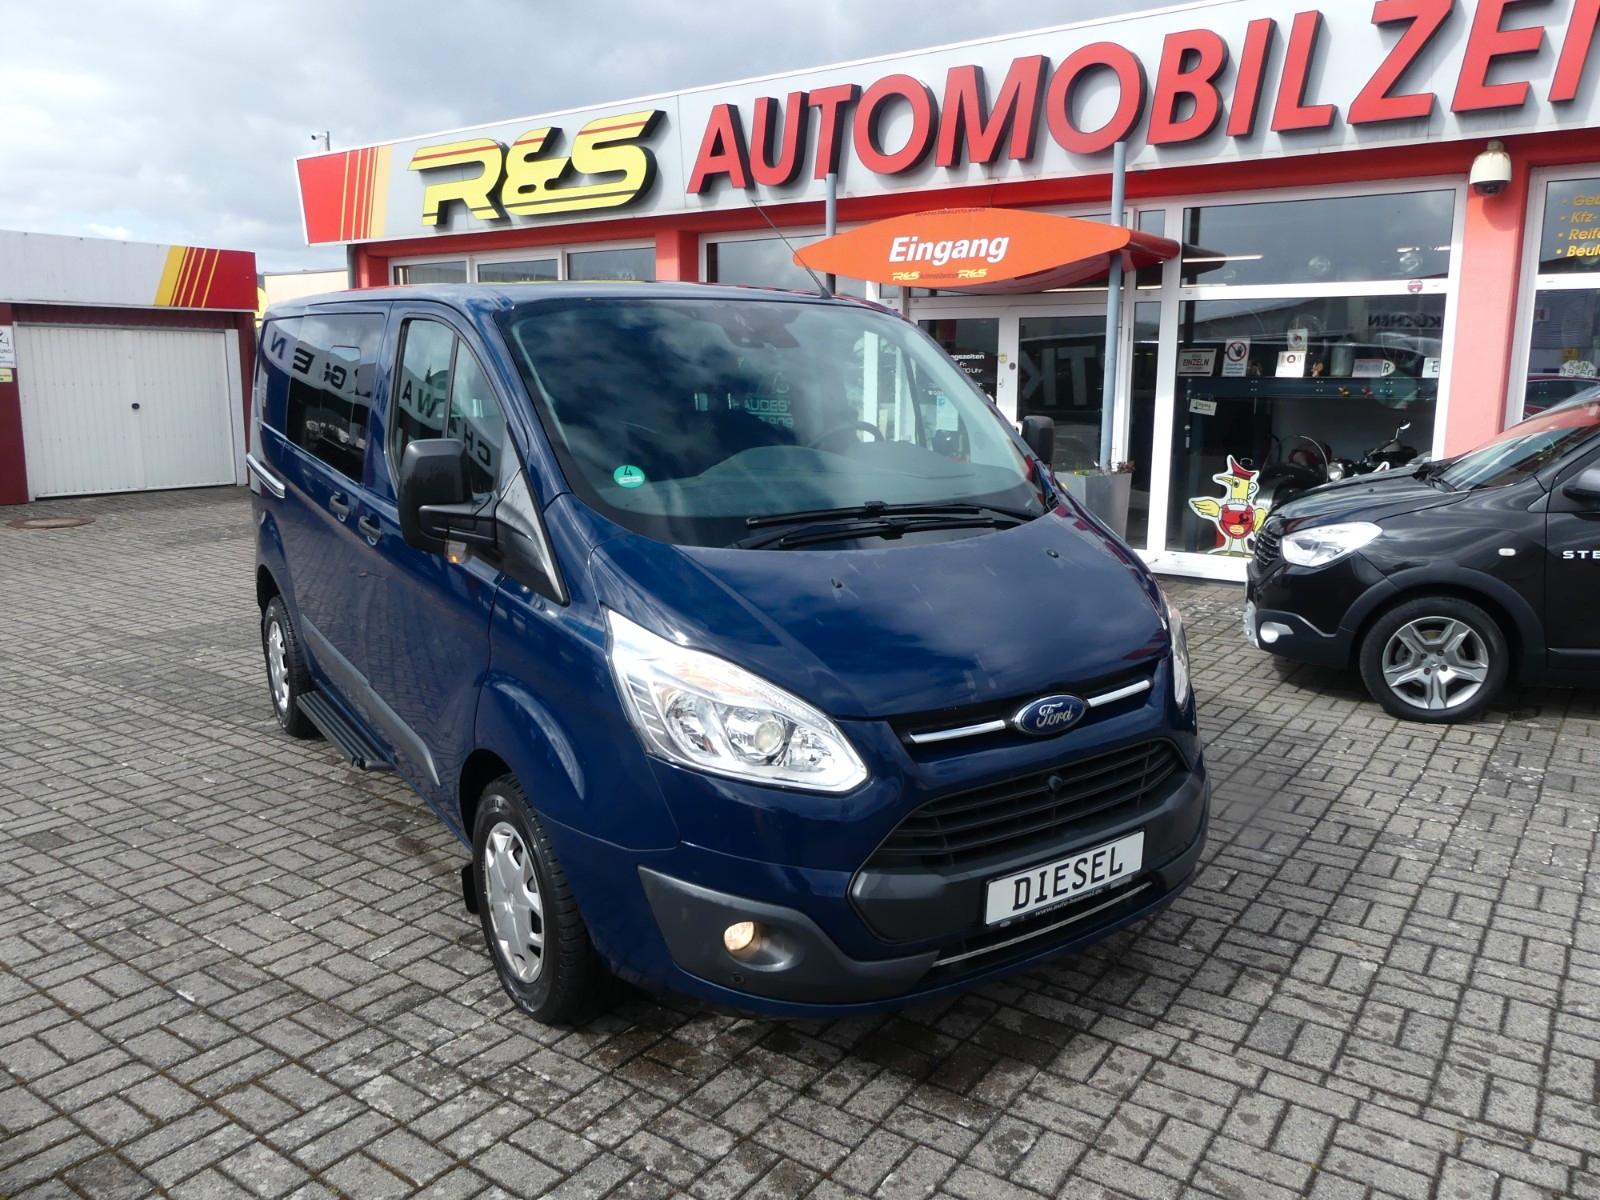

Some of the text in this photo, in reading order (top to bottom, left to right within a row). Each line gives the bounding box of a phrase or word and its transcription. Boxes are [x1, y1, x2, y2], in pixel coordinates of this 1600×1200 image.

[408, 109, 666, 226] R&S
[889, 236, 1010, 266] Eingang
[623, 465, 633, 476] 4
[1036, 702, 1073, 728] Ford
[1012, 846, 1123, 911] DIESEL
